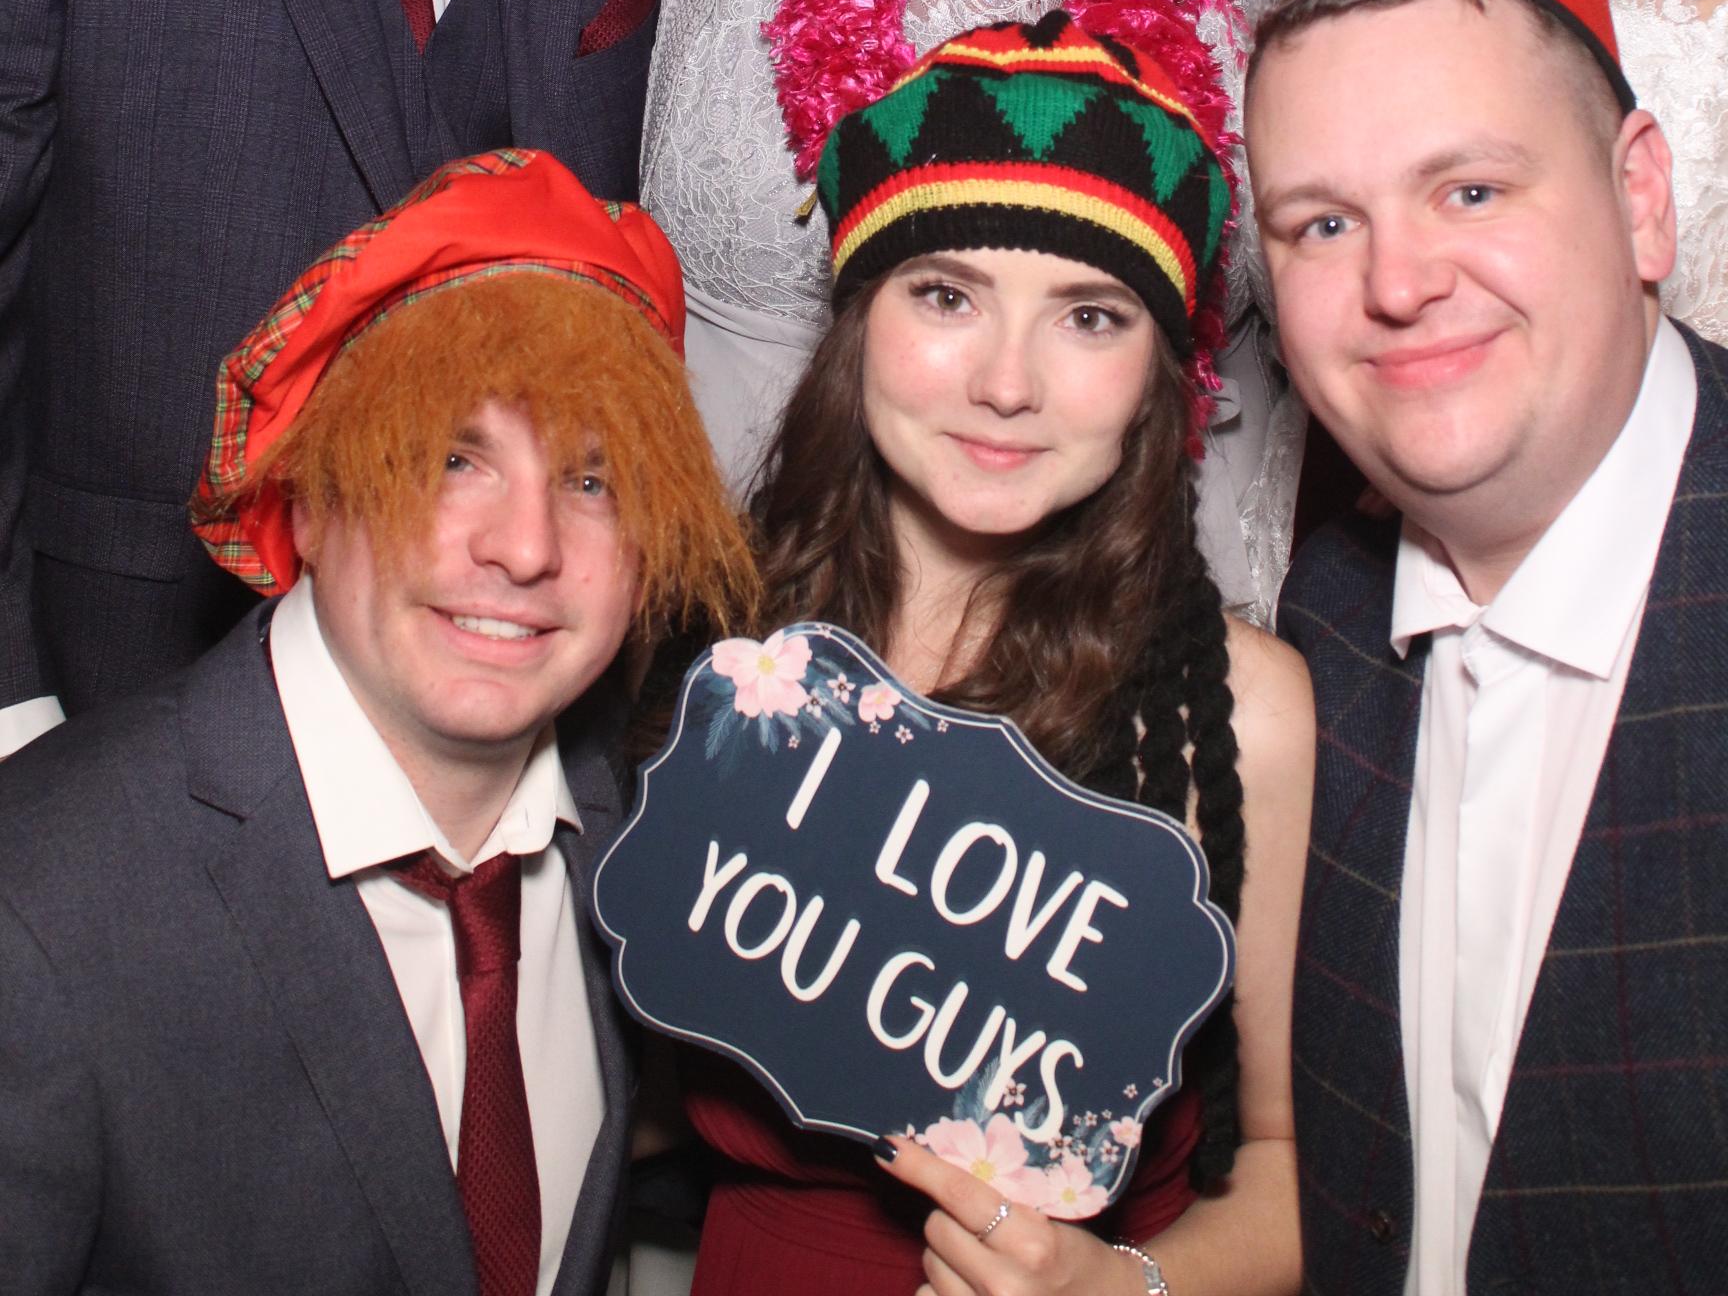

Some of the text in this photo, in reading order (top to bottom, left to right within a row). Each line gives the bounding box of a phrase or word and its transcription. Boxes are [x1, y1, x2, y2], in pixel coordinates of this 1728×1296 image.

[687, 840, 1083, 1143] YOU GUYS
[786, 727, 1128, 992] I LOVE
